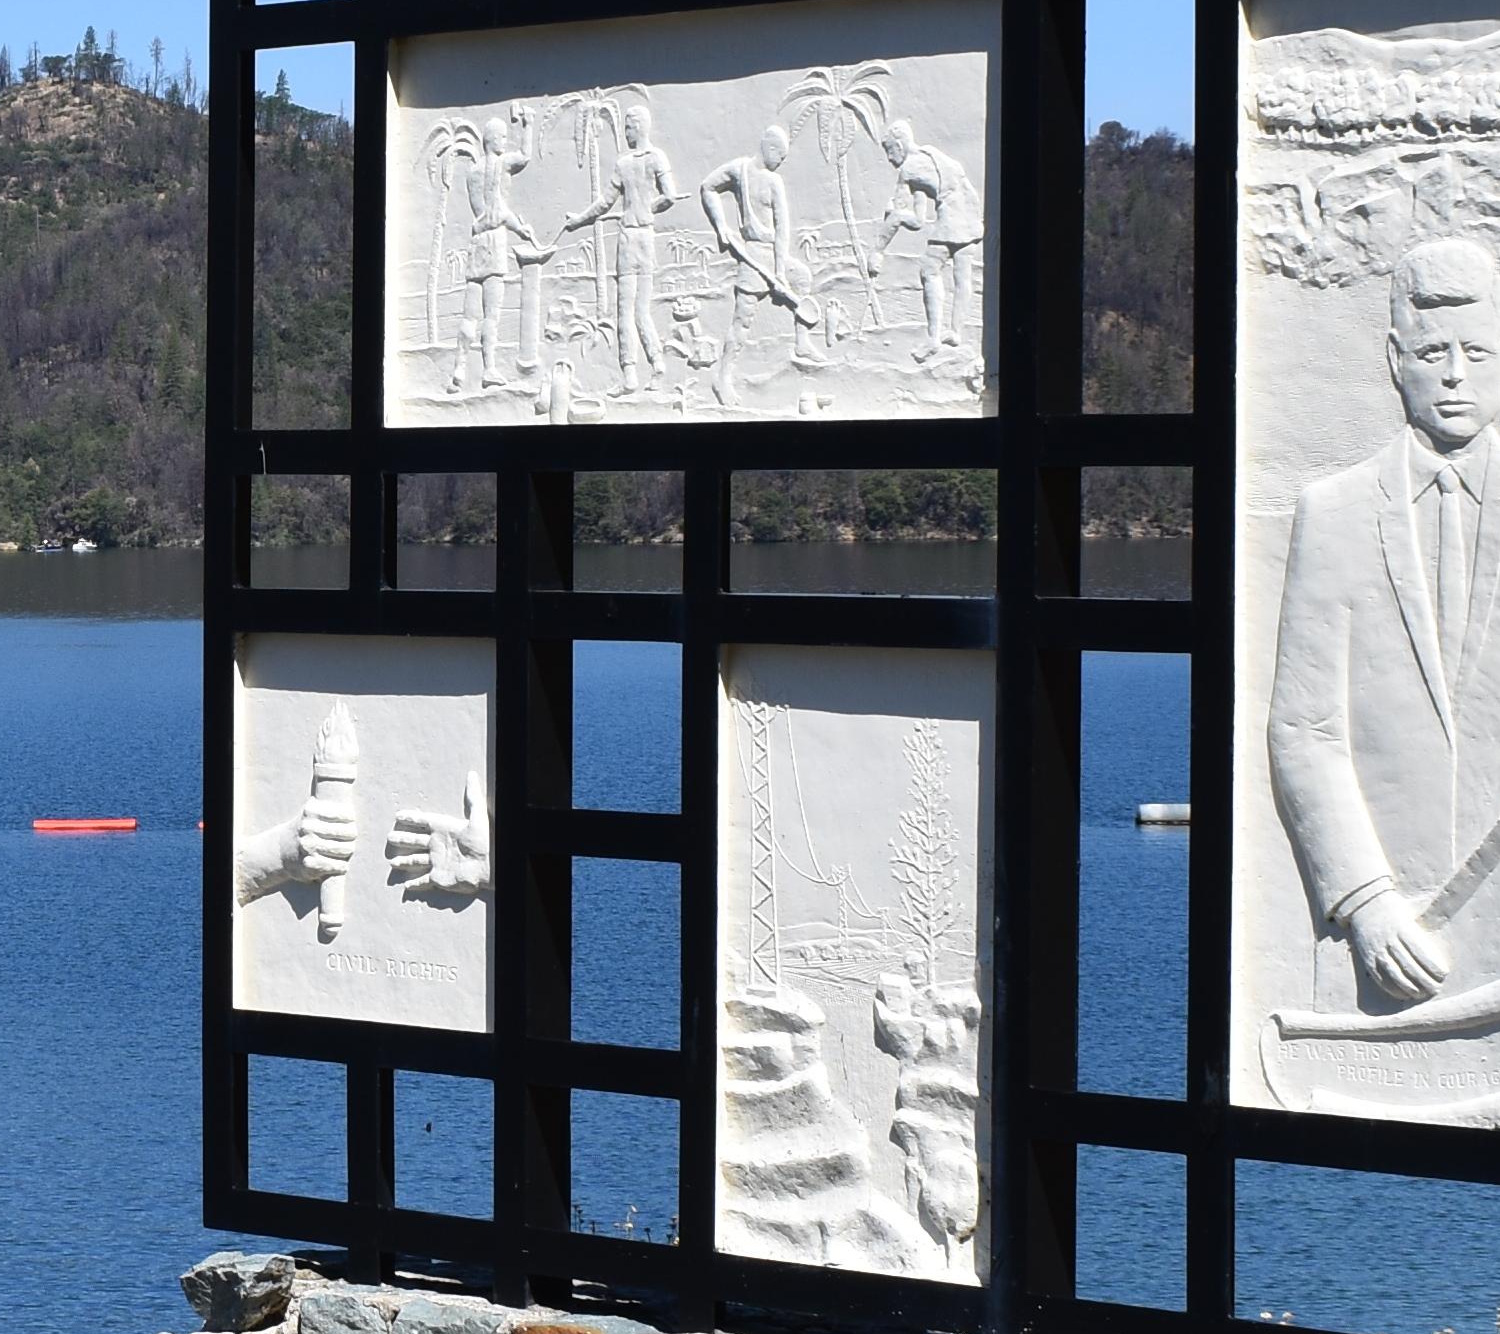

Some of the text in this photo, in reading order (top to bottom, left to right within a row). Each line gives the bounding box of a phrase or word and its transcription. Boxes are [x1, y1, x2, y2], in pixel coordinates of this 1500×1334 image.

[326, 952, 458, 983] CIVIL RIGHTS
[1278, 1042, 1429, 1061] HE WAS HIS OWN
[1337, 1065, 1404, 1087] PROFILE
[1414, 1071, 1429, 1088] IN
